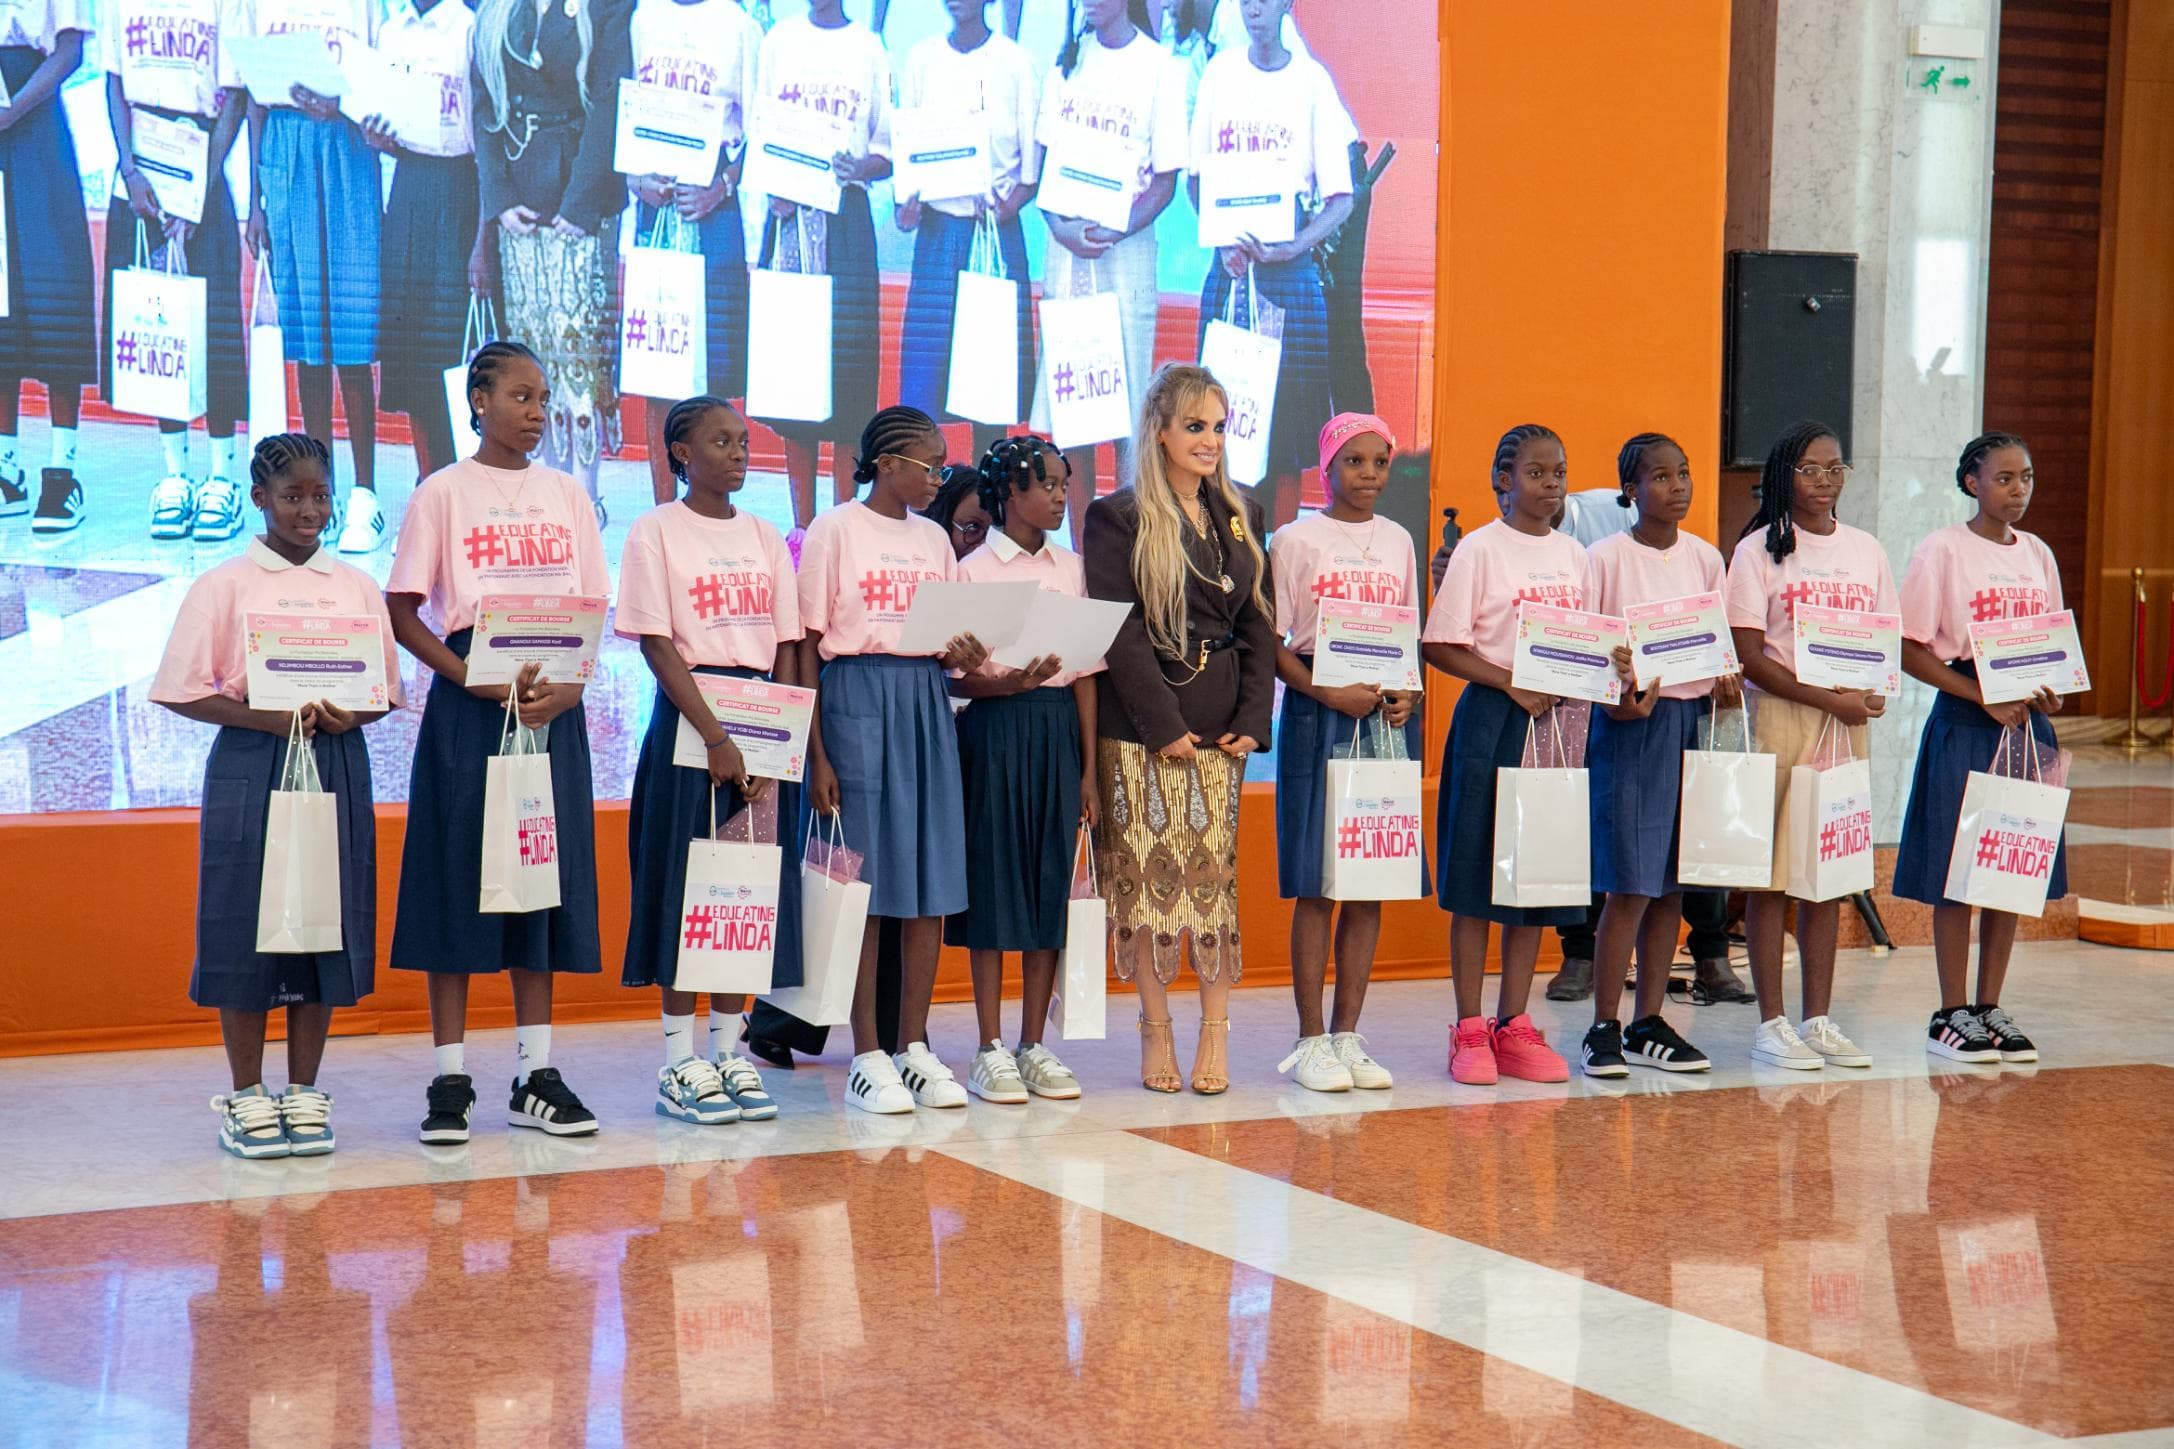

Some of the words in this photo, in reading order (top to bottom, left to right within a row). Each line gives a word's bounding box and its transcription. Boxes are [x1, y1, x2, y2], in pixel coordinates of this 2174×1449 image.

[1360, 815, 1419, 830] EDUCATING
[1362, 830, 1418, 858] LINDA
[2000, 830, 2056, 854] EDUCATING
[1997, 845, 2048, 879] LINDA
[712, 905, 775, 921] EDUCATING
[711, 921, 771, 951] LINDA
